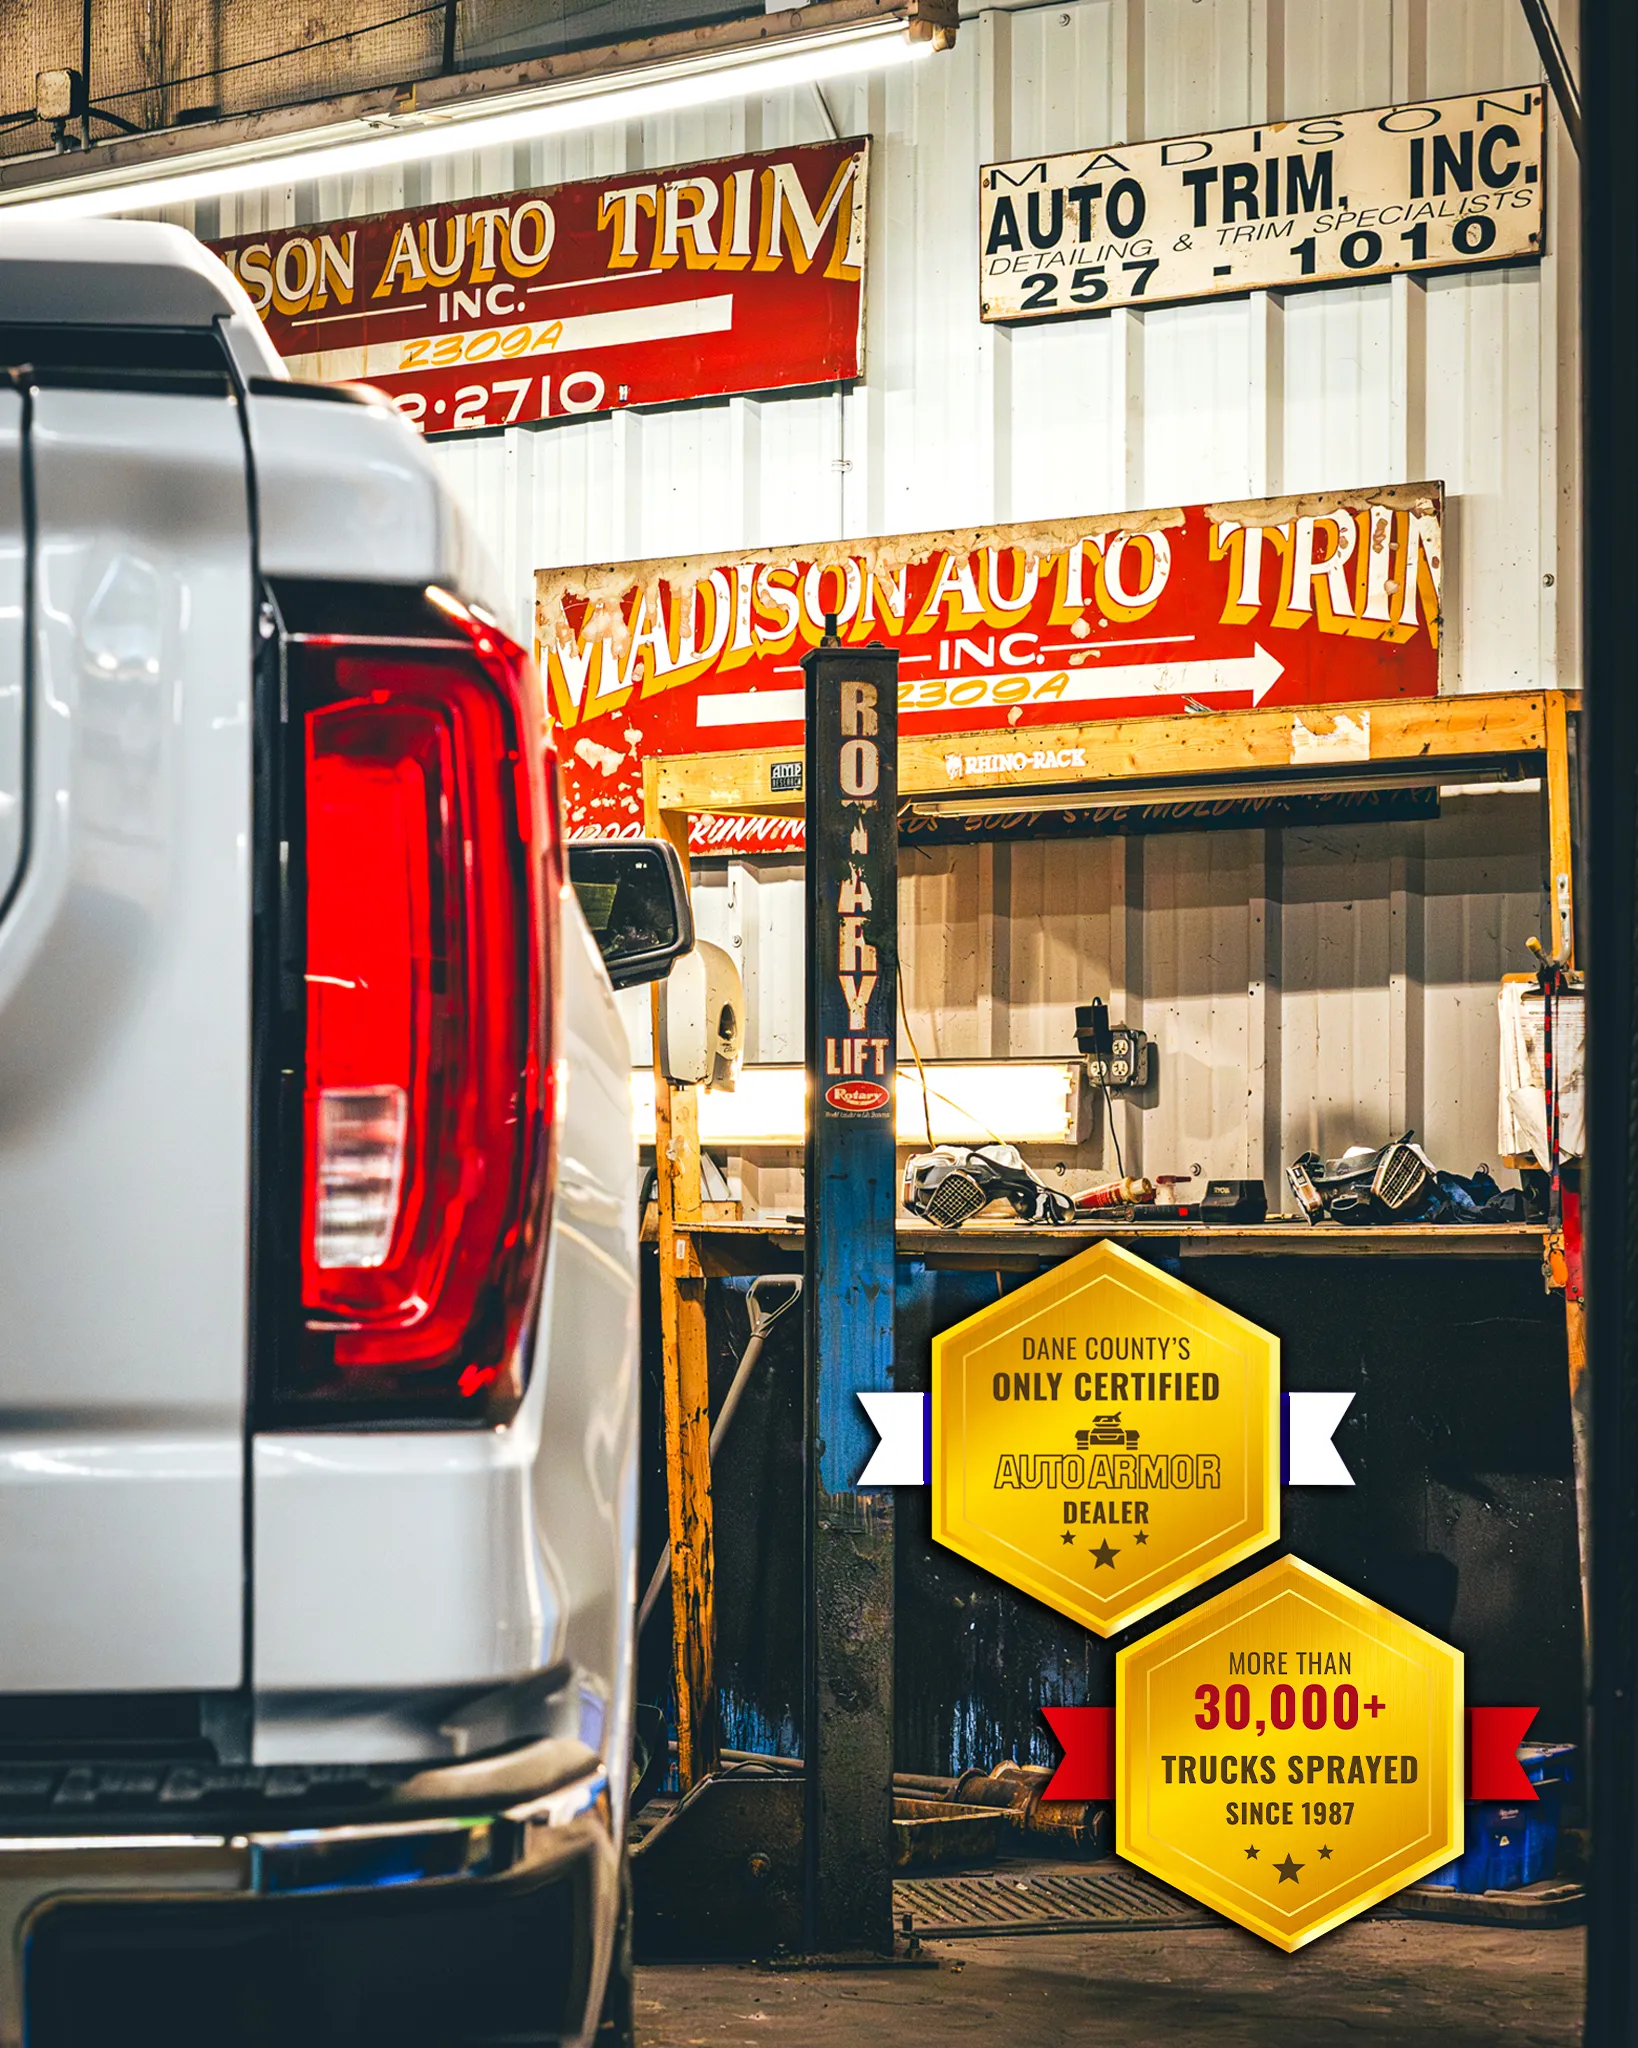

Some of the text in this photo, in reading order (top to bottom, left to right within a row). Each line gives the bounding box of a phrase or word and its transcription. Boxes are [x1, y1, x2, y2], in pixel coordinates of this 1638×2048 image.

[989, 93, 1533, 190] MADISON
[985, 177, 1147, 256] AUTO
[1410, 124, 1539, 199] INC.
[375, 199, 556, 297] AUTO
[598, 152, 864, 281] TRIM
[989, 188, 1533, 276] DETAILING & TRIM SPECIALISTS
[1020, 259, 1160, 310] 257
[1290, 214, 1498, 275] 1010
[438, 284, 526, 324] INC.
[398, 320, 563, 371] 2309A
[540, 557, 908, 728] MADISON
[907, 530, 1172, 633] AUTO
[938, 632, 1046, 671] INC.
[772, 764, 802, 778] AMP
[965, 748, 1086, 775] RHINO-RACK
[688, 816, 806, 845] RUNNIN
[825, 1037, 891, 1076] LIFT
[833, 1087, 883, 1105] Rotary
